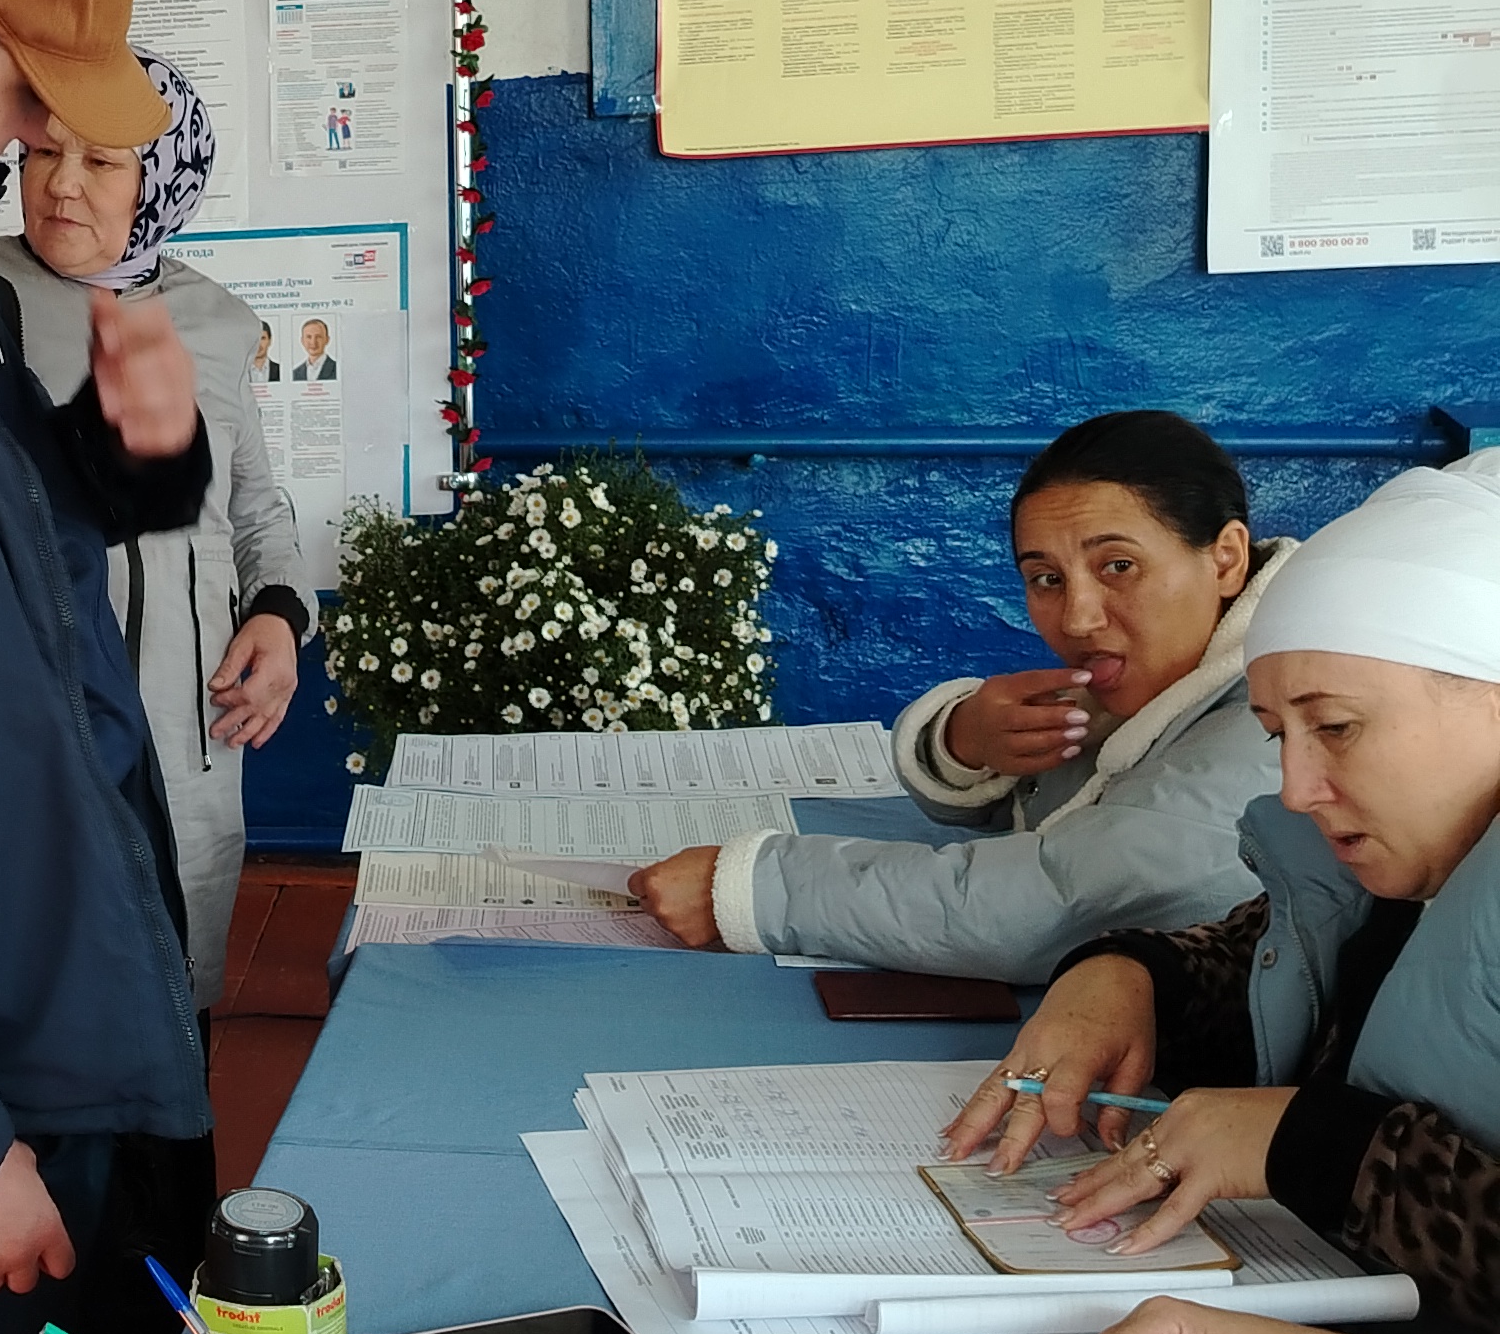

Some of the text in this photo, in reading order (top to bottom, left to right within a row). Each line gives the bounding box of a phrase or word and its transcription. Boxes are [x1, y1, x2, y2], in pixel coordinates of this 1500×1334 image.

[1298, 240, 1317, 248] 800
[1319, 238, 1339, 247] 200
[1341, 237, 1354, 246] 00
[1356, 237, 1369, 246] 20
[161, 248, 214, 258] 026 года
[285, 278, 313, 288] Думы
[266, 291, 300, 300] созыва
[316, 1292, 344, 1318] trodat
[216, 1306, 261, 1324] trodat
